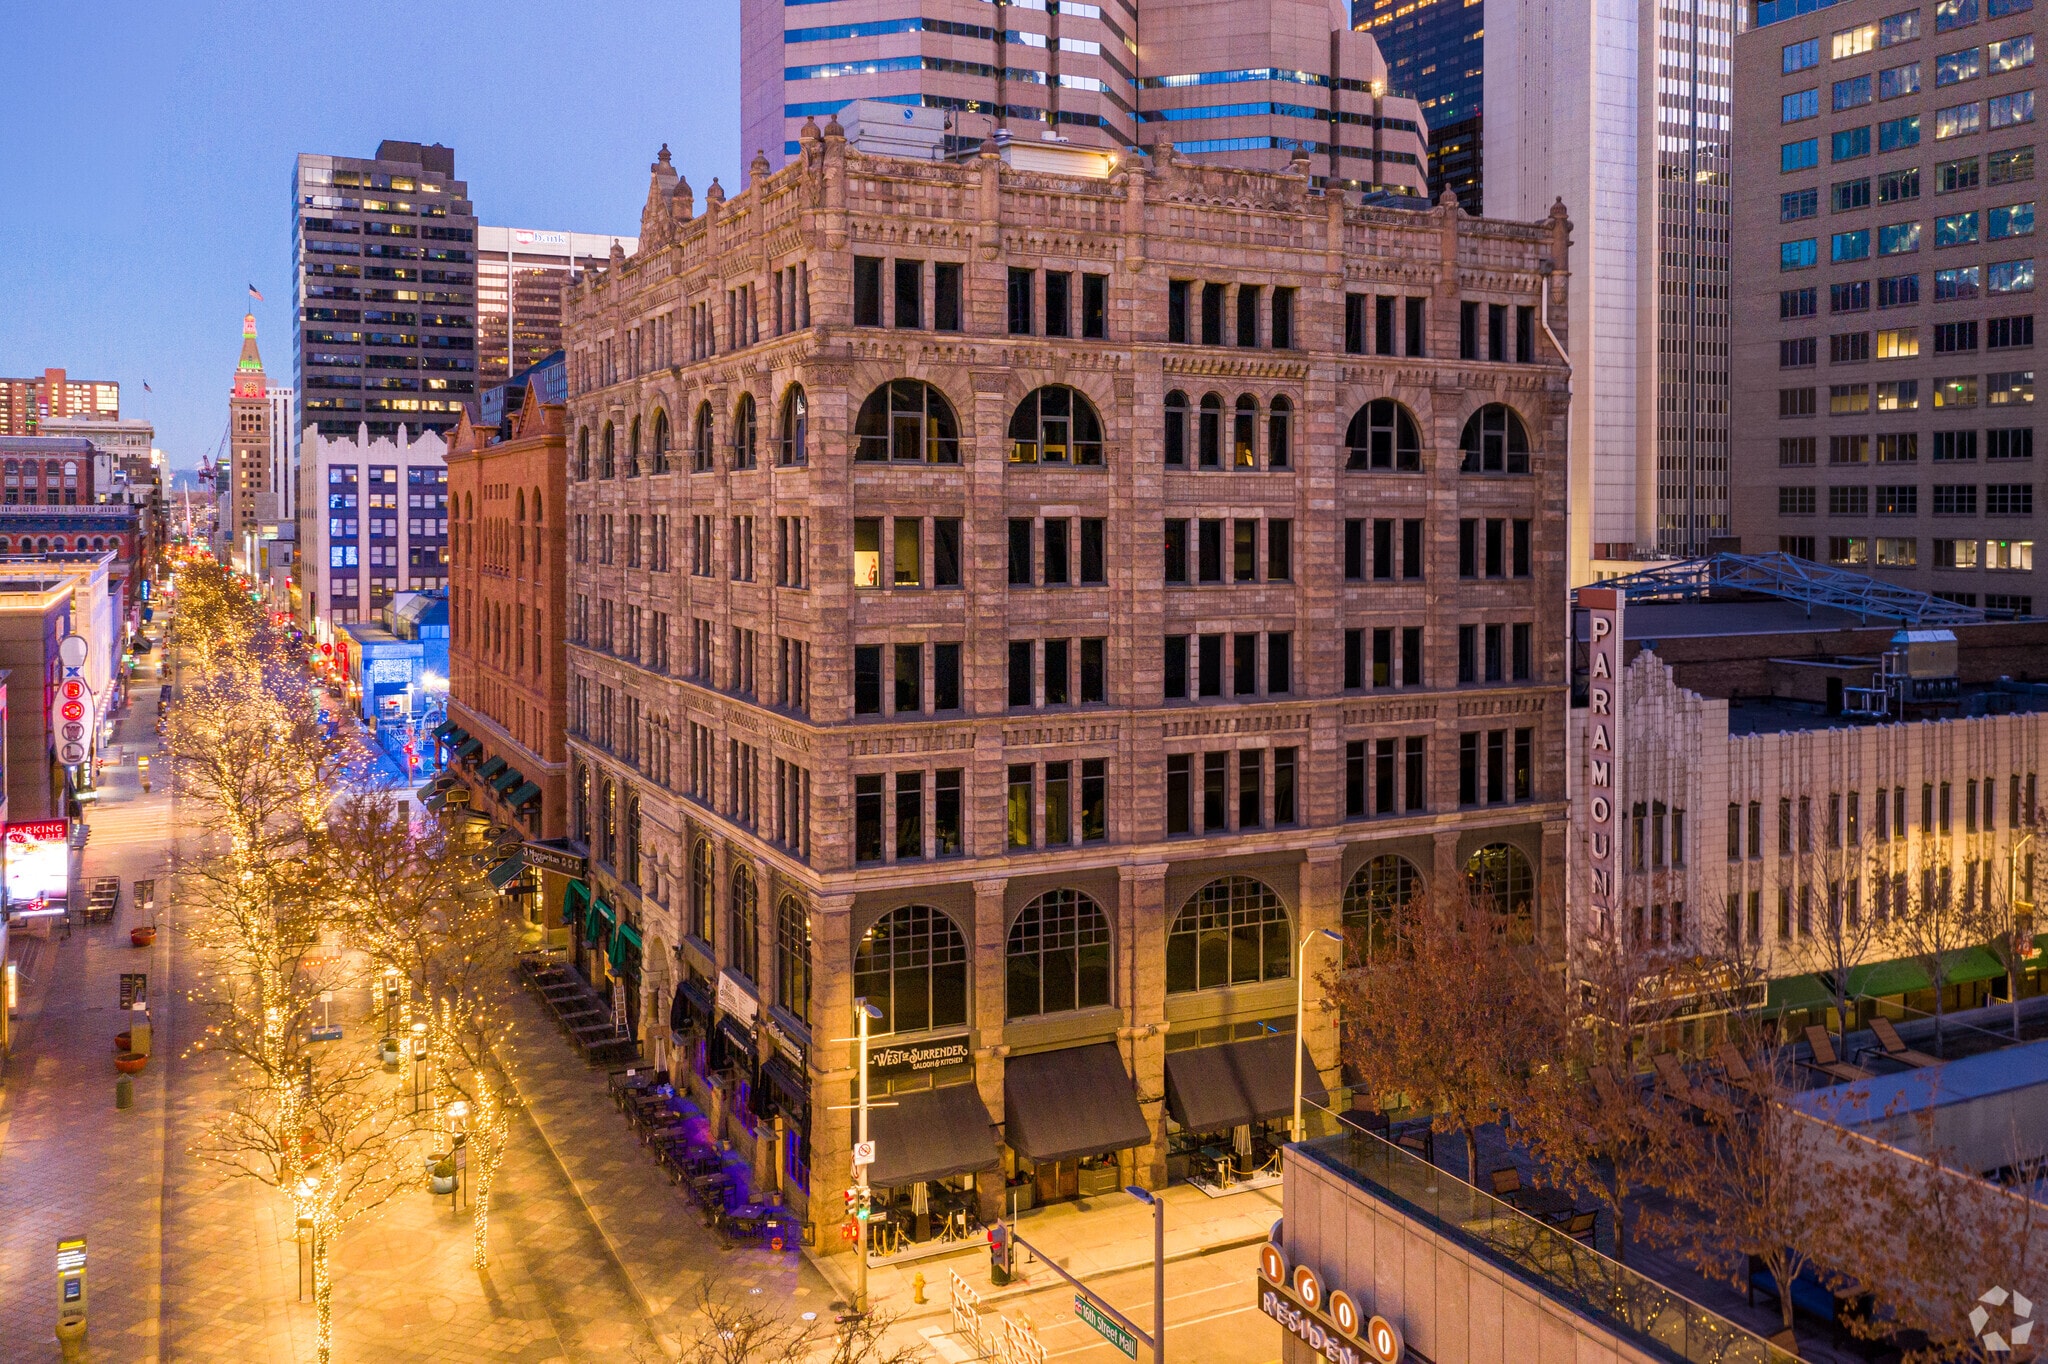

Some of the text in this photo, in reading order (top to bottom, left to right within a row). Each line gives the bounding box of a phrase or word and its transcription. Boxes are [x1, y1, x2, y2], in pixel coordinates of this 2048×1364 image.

[534, 233, 565, 244] bank
[64, 682, 82, 760] BOWL
[1592, 617, 1611, 932] PARAMOUNT
[8, 833, 63, 843] AVAABLE
[10, 825, 63, 835] PARKING
[522, 847, 560, 864] 3 Margaritas
[1669, 974, 1727, 992] PARAUNT
[873, 1049, 903, 1067] WEST
[909, 1045, 968, 1064] SURRENDER
[912, 1057, 964, 1070] SALOON & KITCHEN
[1268, 1254, 1392, 1355] 1600
[1083, 1305, 1134, 1356] 16th Street Mall
[1263, 1291, 1374, 1364] RESIDEN
